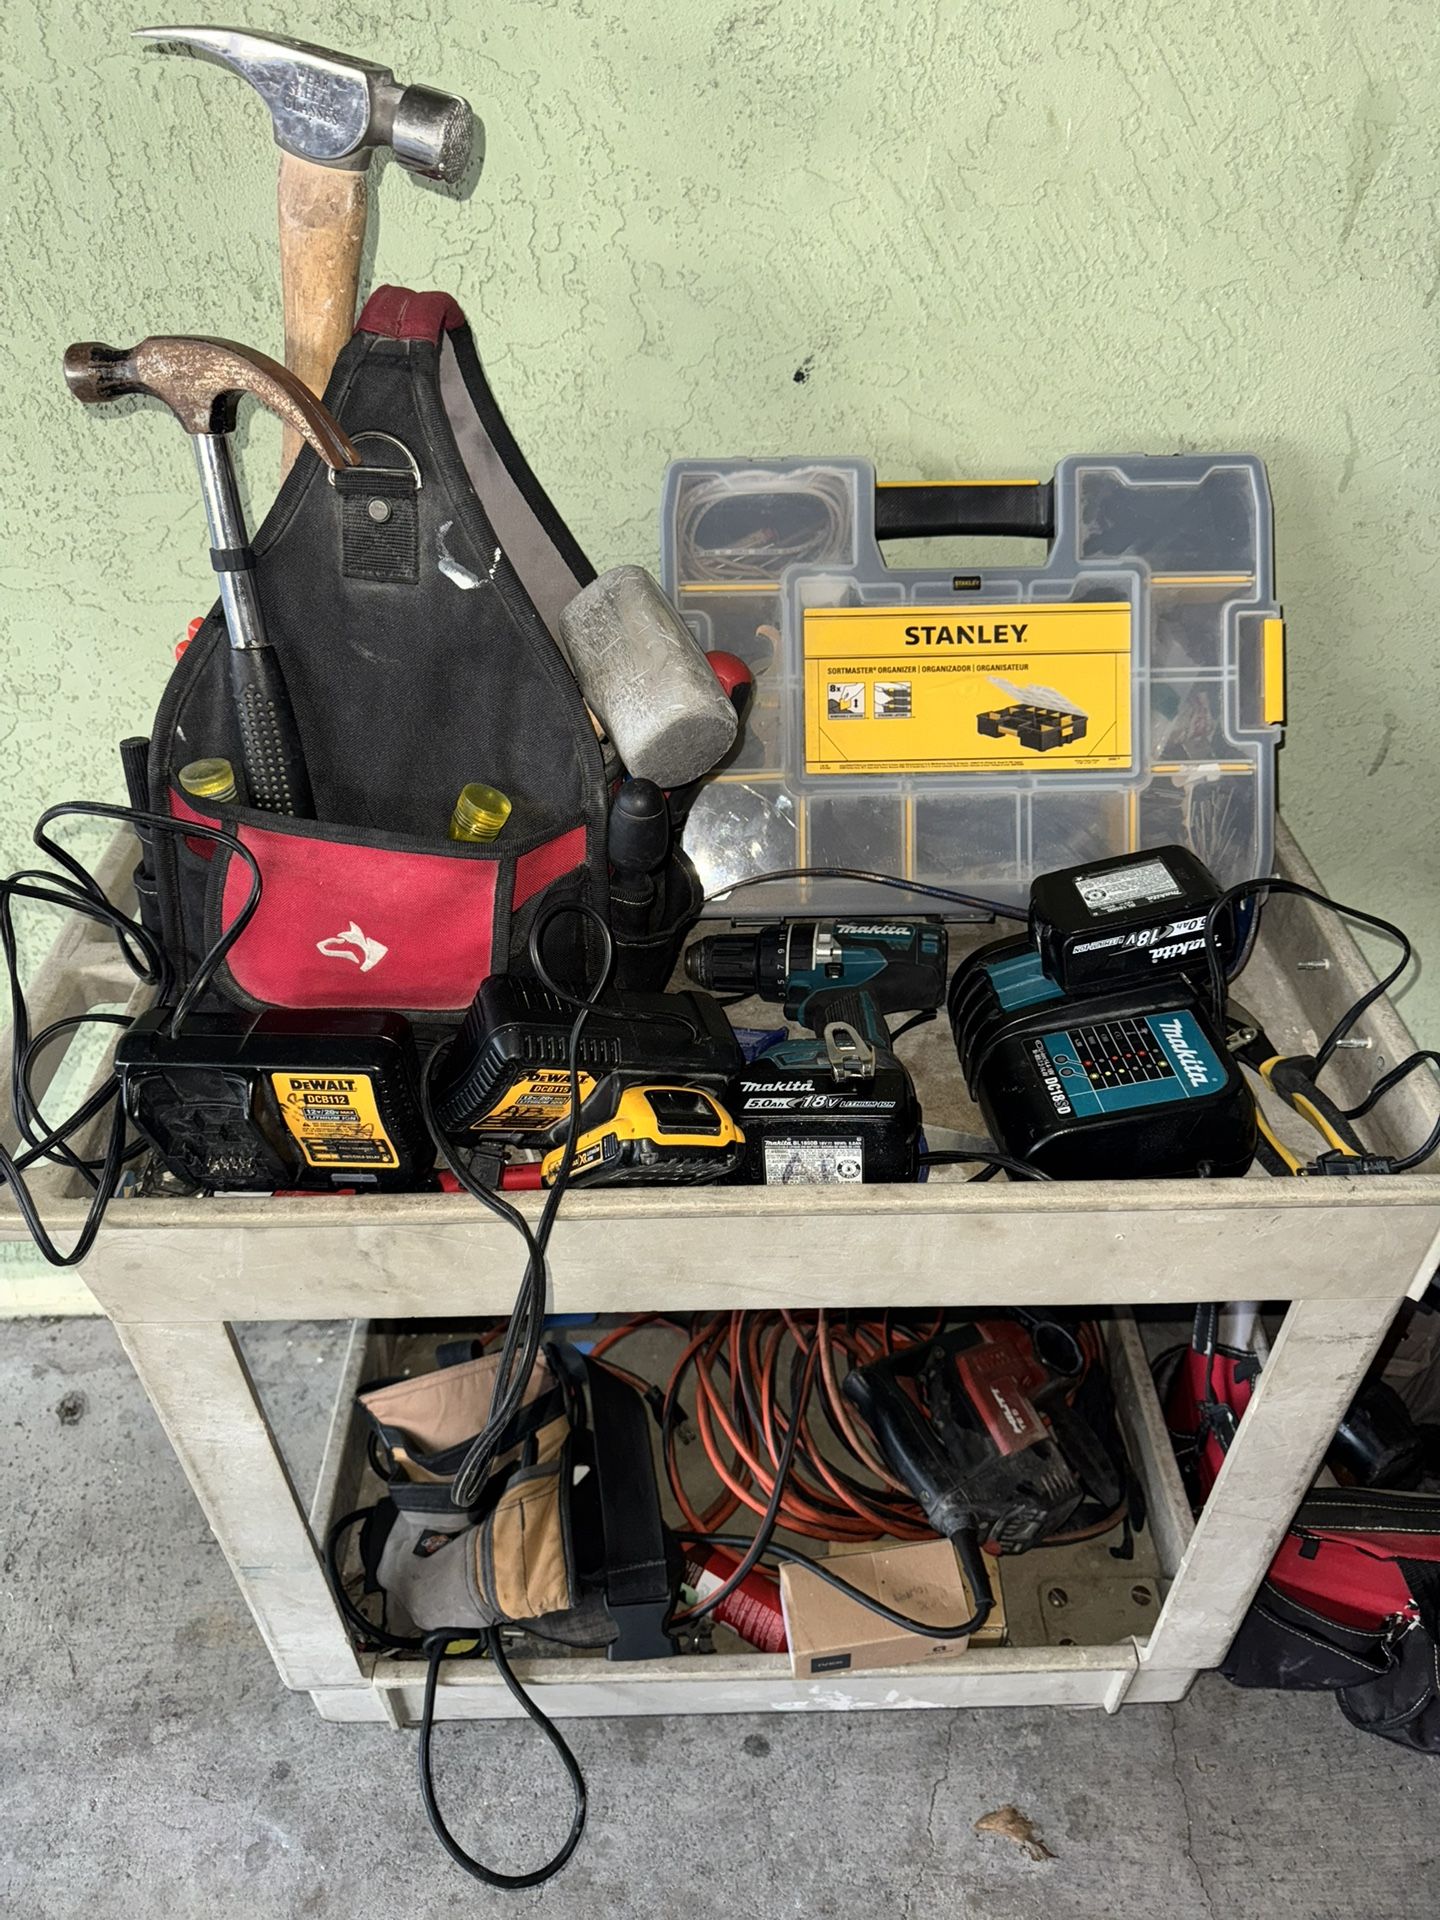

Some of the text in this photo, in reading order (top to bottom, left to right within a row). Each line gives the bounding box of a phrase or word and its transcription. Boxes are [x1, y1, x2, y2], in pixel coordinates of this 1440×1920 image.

[283, 95, 339, 127] GLASSES
[905, 624, 1028, 646] STANLEY
[877, 665, 917, 675] ORGANIZER
[921, 664, 972, 674] ORGANIZADOR
[976, 663, 1029, 673] ORGANISATEUR
[829, 684, 841, 693] 8x
[836, 924, 911, 935] makita
[1125, 928, 1159, 947] 18V
[1159, 1018, 1209, 1088] makita
[527, 1073, 589, 1084] DEWAT
[533, 1085, 569, 1093] DCB115
[740, 1080, 816, 1092] makita
[307, 1094, 347, 1104] DCB112
[803, 1095, 840, 1108] 18V
[1044, 1076, 1072, 1115] DC18SD
